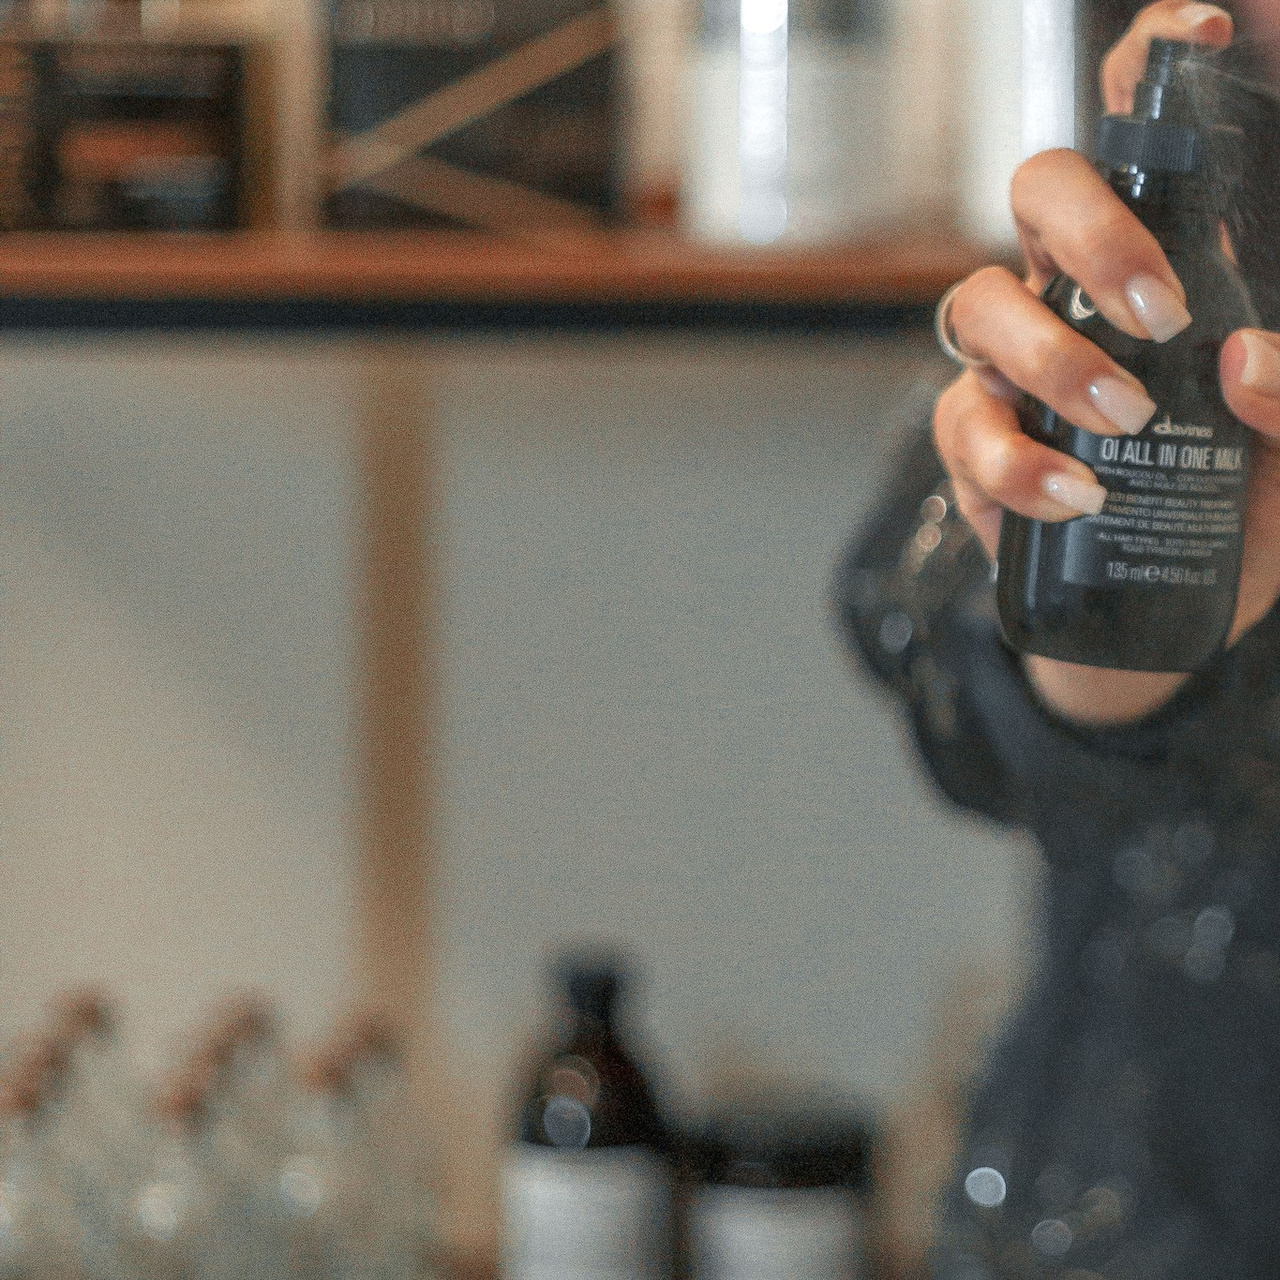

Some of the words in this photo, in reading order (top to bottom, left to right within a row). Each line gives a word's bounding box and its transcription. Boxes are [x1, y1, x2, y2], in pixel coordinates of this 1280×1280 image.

[1123, 439, 1154, 465] ALL
[1158, 444, 1177, 466] IN
[1180, 445, 1213, 469] ONE
[1107, 562, 1128, 580] 135
